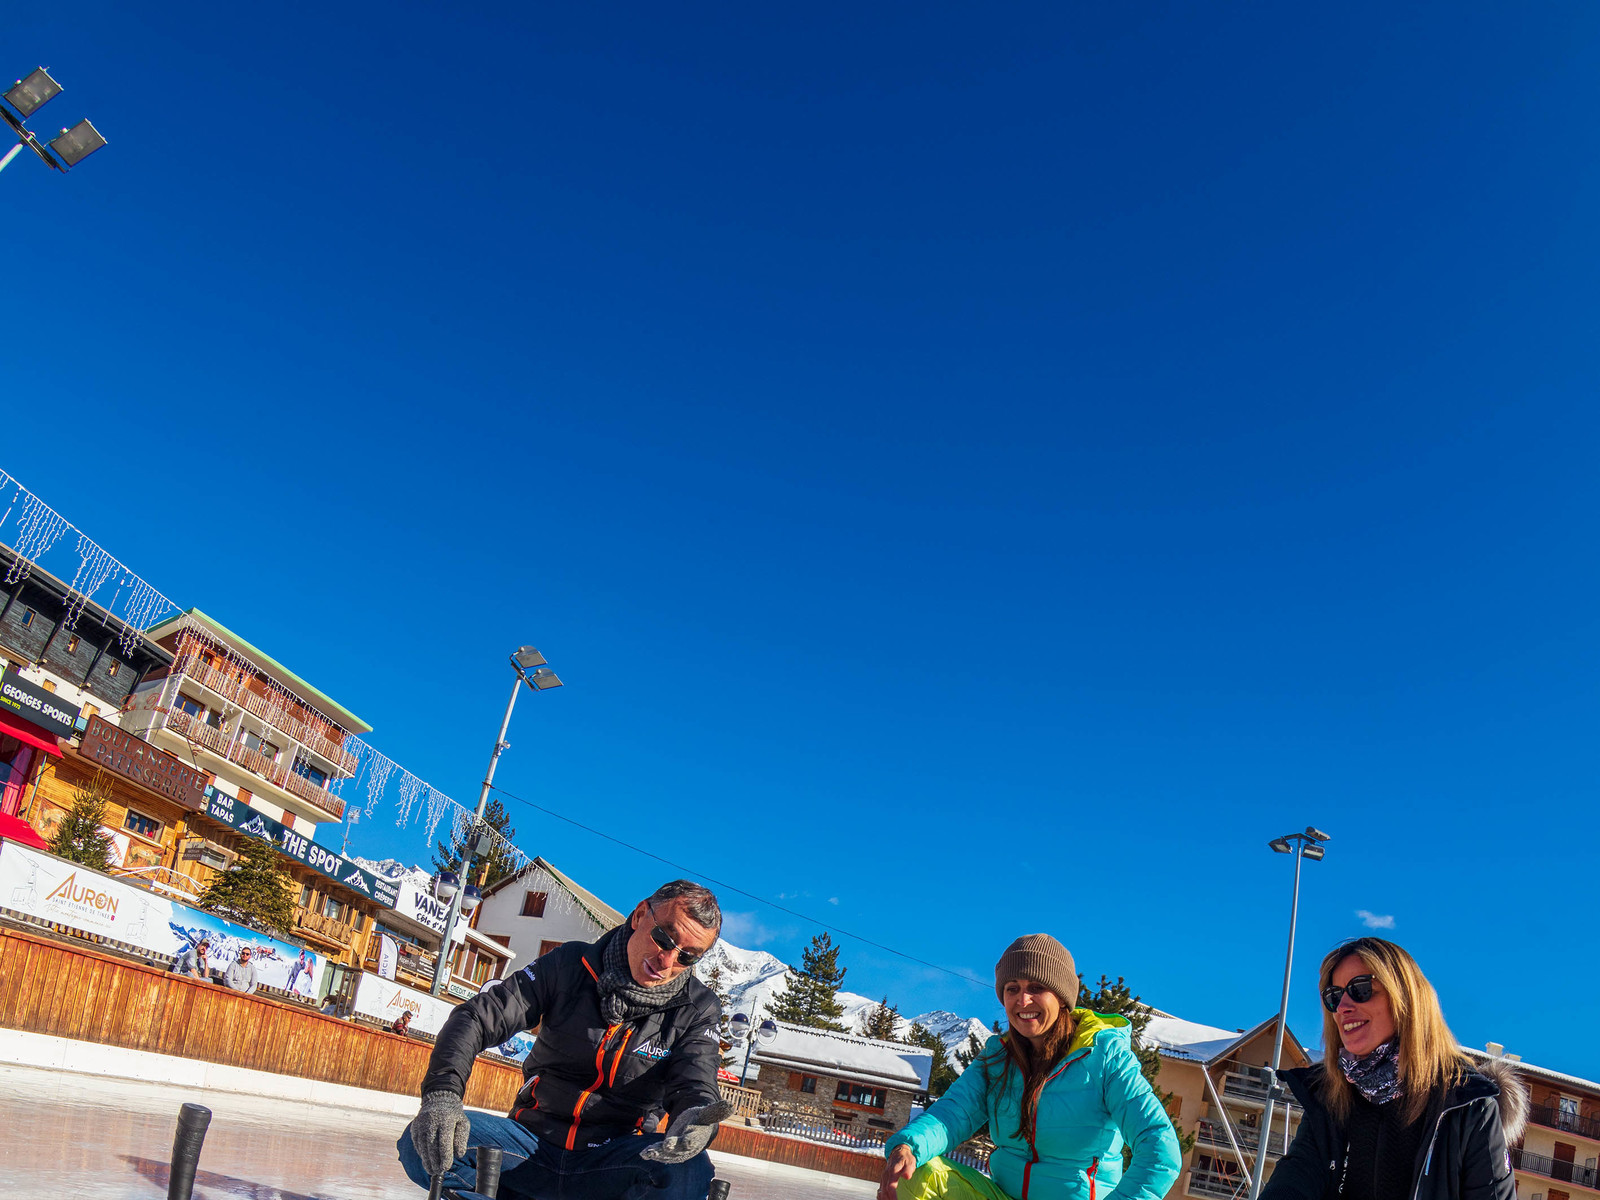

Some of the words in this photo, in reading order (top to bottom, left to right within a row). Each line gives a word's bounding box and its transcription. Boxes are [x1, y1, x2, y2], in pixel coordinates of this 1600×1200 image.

[3, 684, 42, 711] GEORGES
[41, 703, 73, 726] SPORTS
[91, 720, 206, 792] BOULANGERIE
[211, 803, 235, 823] TAPAS
[216, 792, 234, 810] BAR
[282, 829, 308, 860] THE
[308, 845, 343, 877] SPOT
[45, 871, 119, 914] AURON
[386, 989, 422, 1013] AURON
